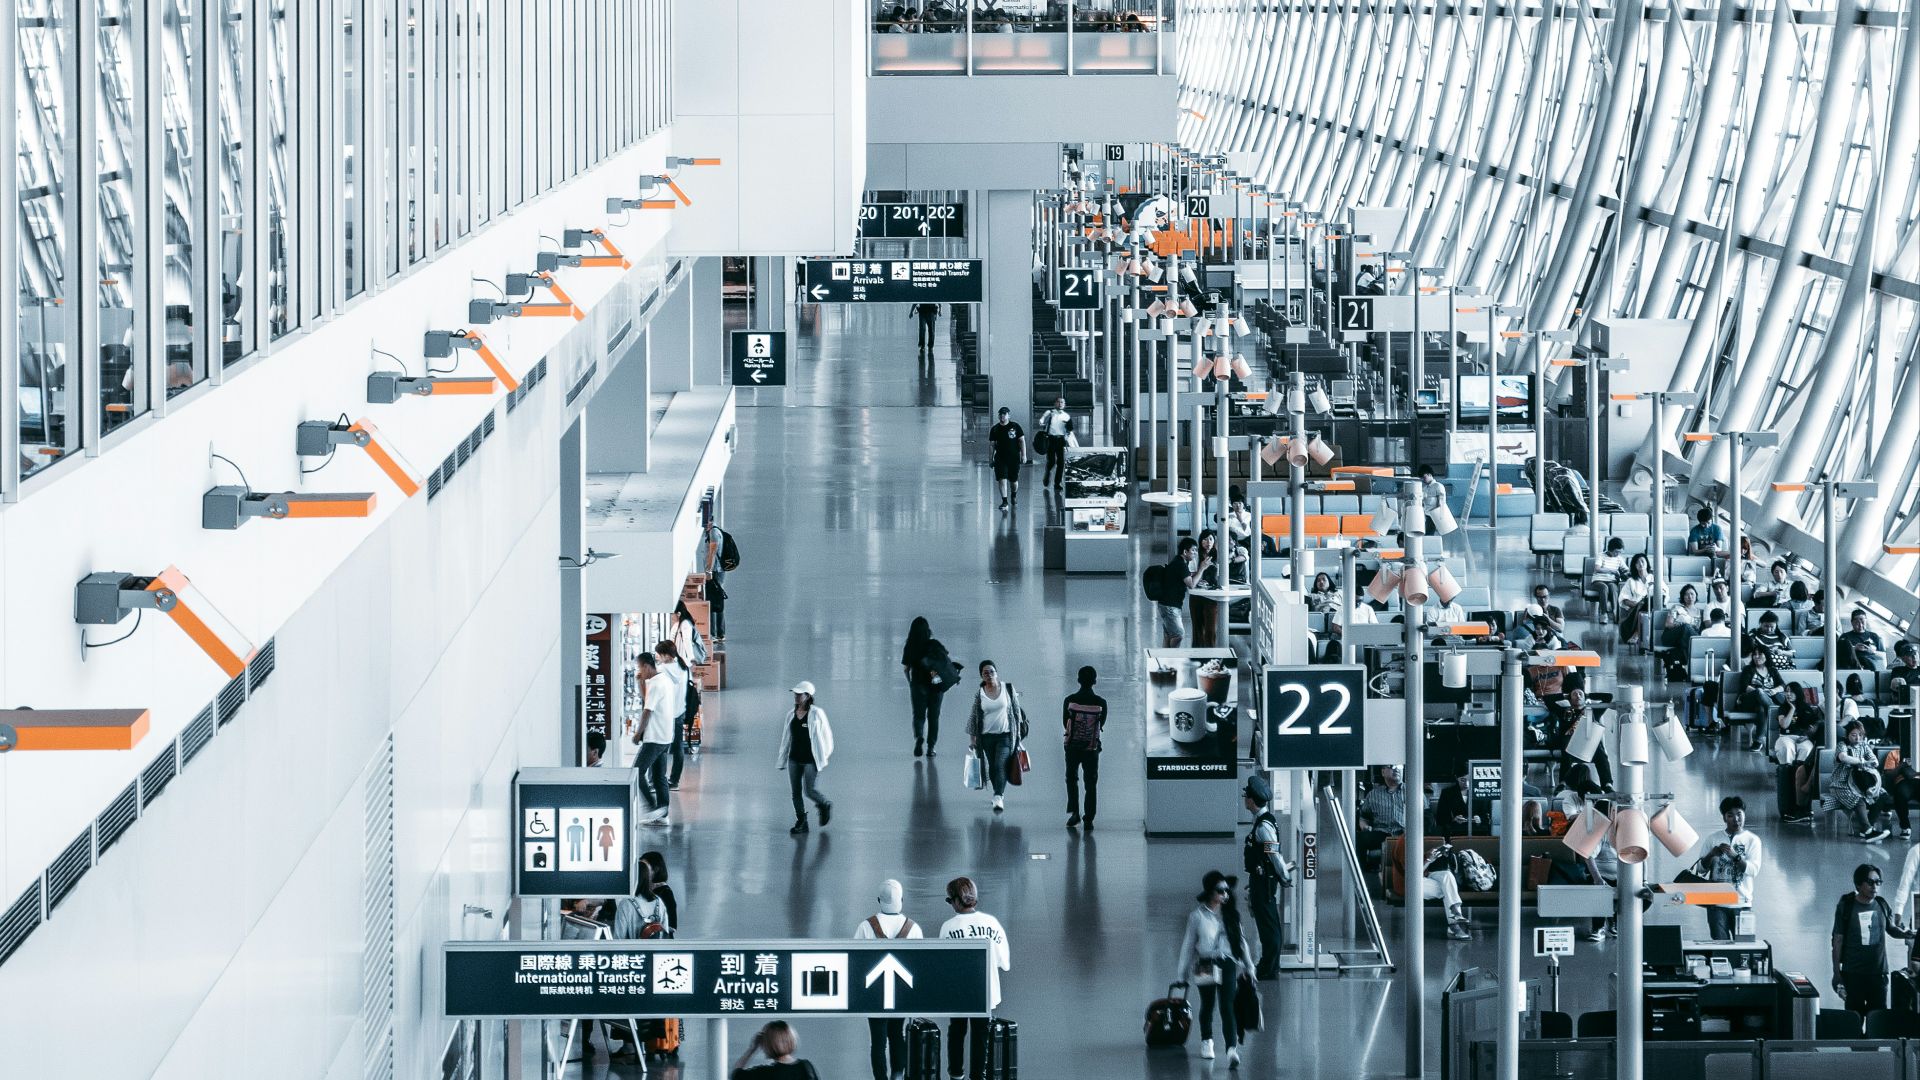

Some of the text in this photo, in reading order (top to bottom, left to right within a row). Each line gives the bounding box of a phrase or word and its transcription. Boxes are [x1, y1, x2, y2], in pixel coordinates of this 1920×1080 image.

[1110, 146, 1122, 160] 19
[928, 206, 955, 219] 202
[1190, 198, 1207, 216] 20
[853, 276, 884, 285] Arrivals
[1065, 273, 1093, 296] 21
[1347, 301, 1368, 328] 21
[1278, 683, 1352, 736] 22
[1306, 848, 1315, 878] AED
[520, 954, 646, 971] 国際線 乗り継ぎ
[515, 971, 646, 983] International Transfer
[713, 978, 779, 994] Arrivals
[720, 998, 779, 1010] 到达 도착
